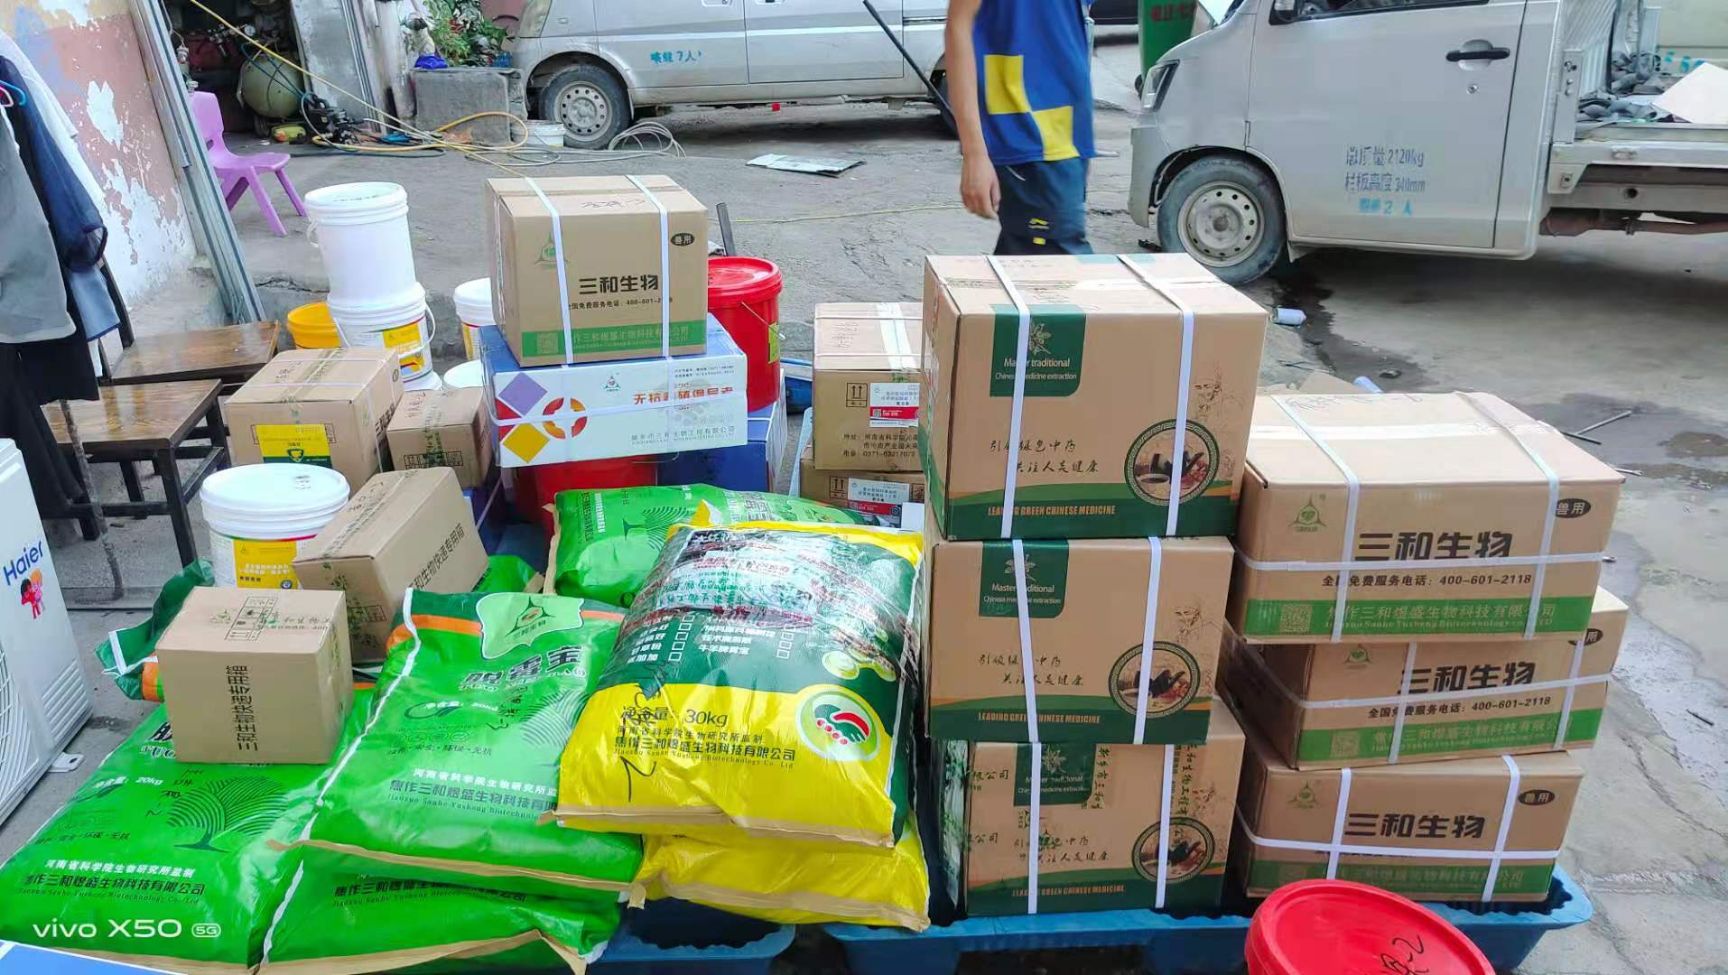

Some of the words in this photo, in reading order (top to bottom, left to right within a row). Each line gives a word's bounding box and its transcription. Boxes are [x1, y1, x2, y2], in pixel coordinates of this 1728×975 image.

[579, 275, 659, 295] 三和生物
[1004, 358, 1029, 367] Mar
[1031, 358, 1070, 368] traditional
[1025, 372, 1046, 380] edicine
[1046, 505, 1078, 515] CHINESE
[1079, 505, 1116, 515] MEDICINE
[1354, 531, 1513, 562] 三和生物
[3, 540, 43, 586] Haier
[1439, 574, 1532, 587] 400-601-2118
[1027, 584, 1055, 593] ditional
[1396, 661, 1537, 697] 三和生物
[1472, 696, 1552, 711] 400-601-2118
[684, 708, 728, 728] 30kg
[1039, 713, 1063, 722] HINESE
[1344, 813, 1487, 839] 三和生物
